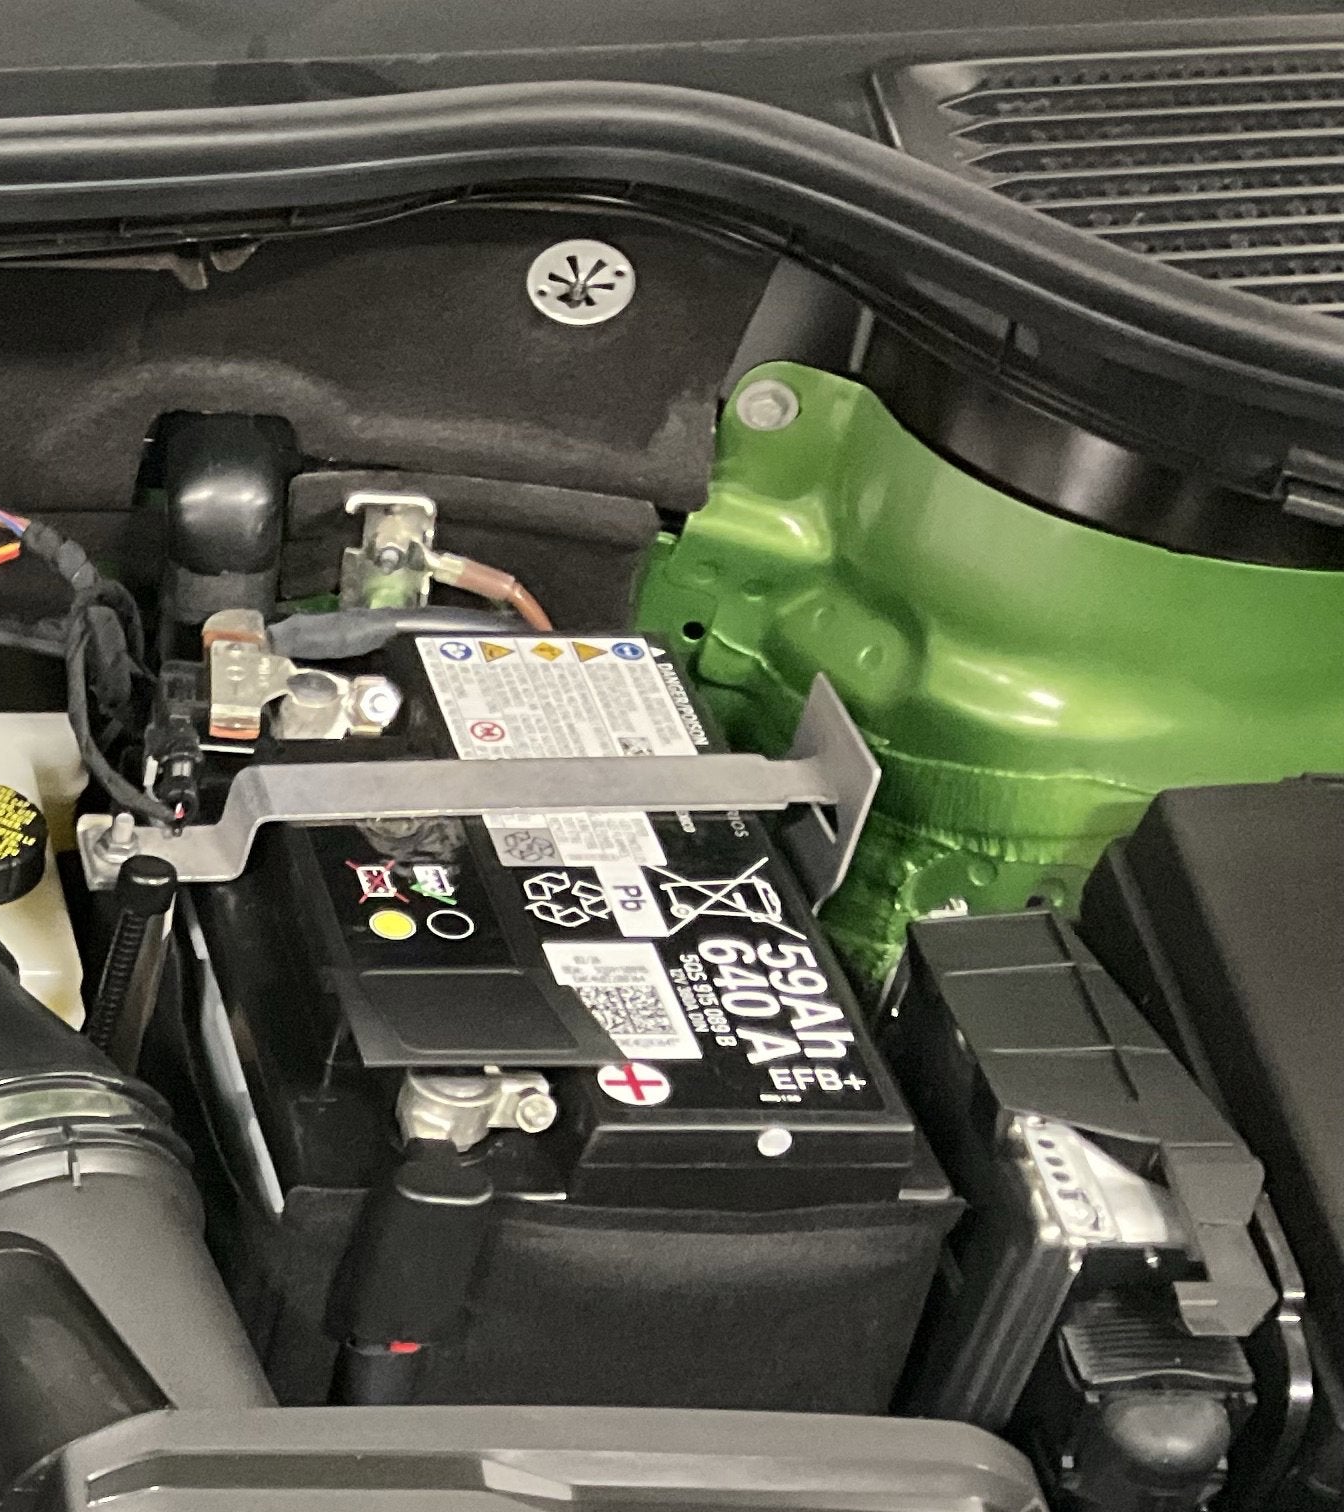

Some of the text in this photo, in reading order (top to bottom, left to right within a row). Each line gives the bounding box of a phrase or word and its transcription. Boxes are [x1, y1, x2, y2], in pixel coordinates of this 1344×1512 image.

[614, 885, 642, 911] Pb
[698, 938, 780, 1018] 640
[757, 943, 855, 1059] 59Ah
[716, 1035, 738, 1047] B
[735, 1028, 801, 1065] A
[768, 1067, 867, 1091] EFB+
